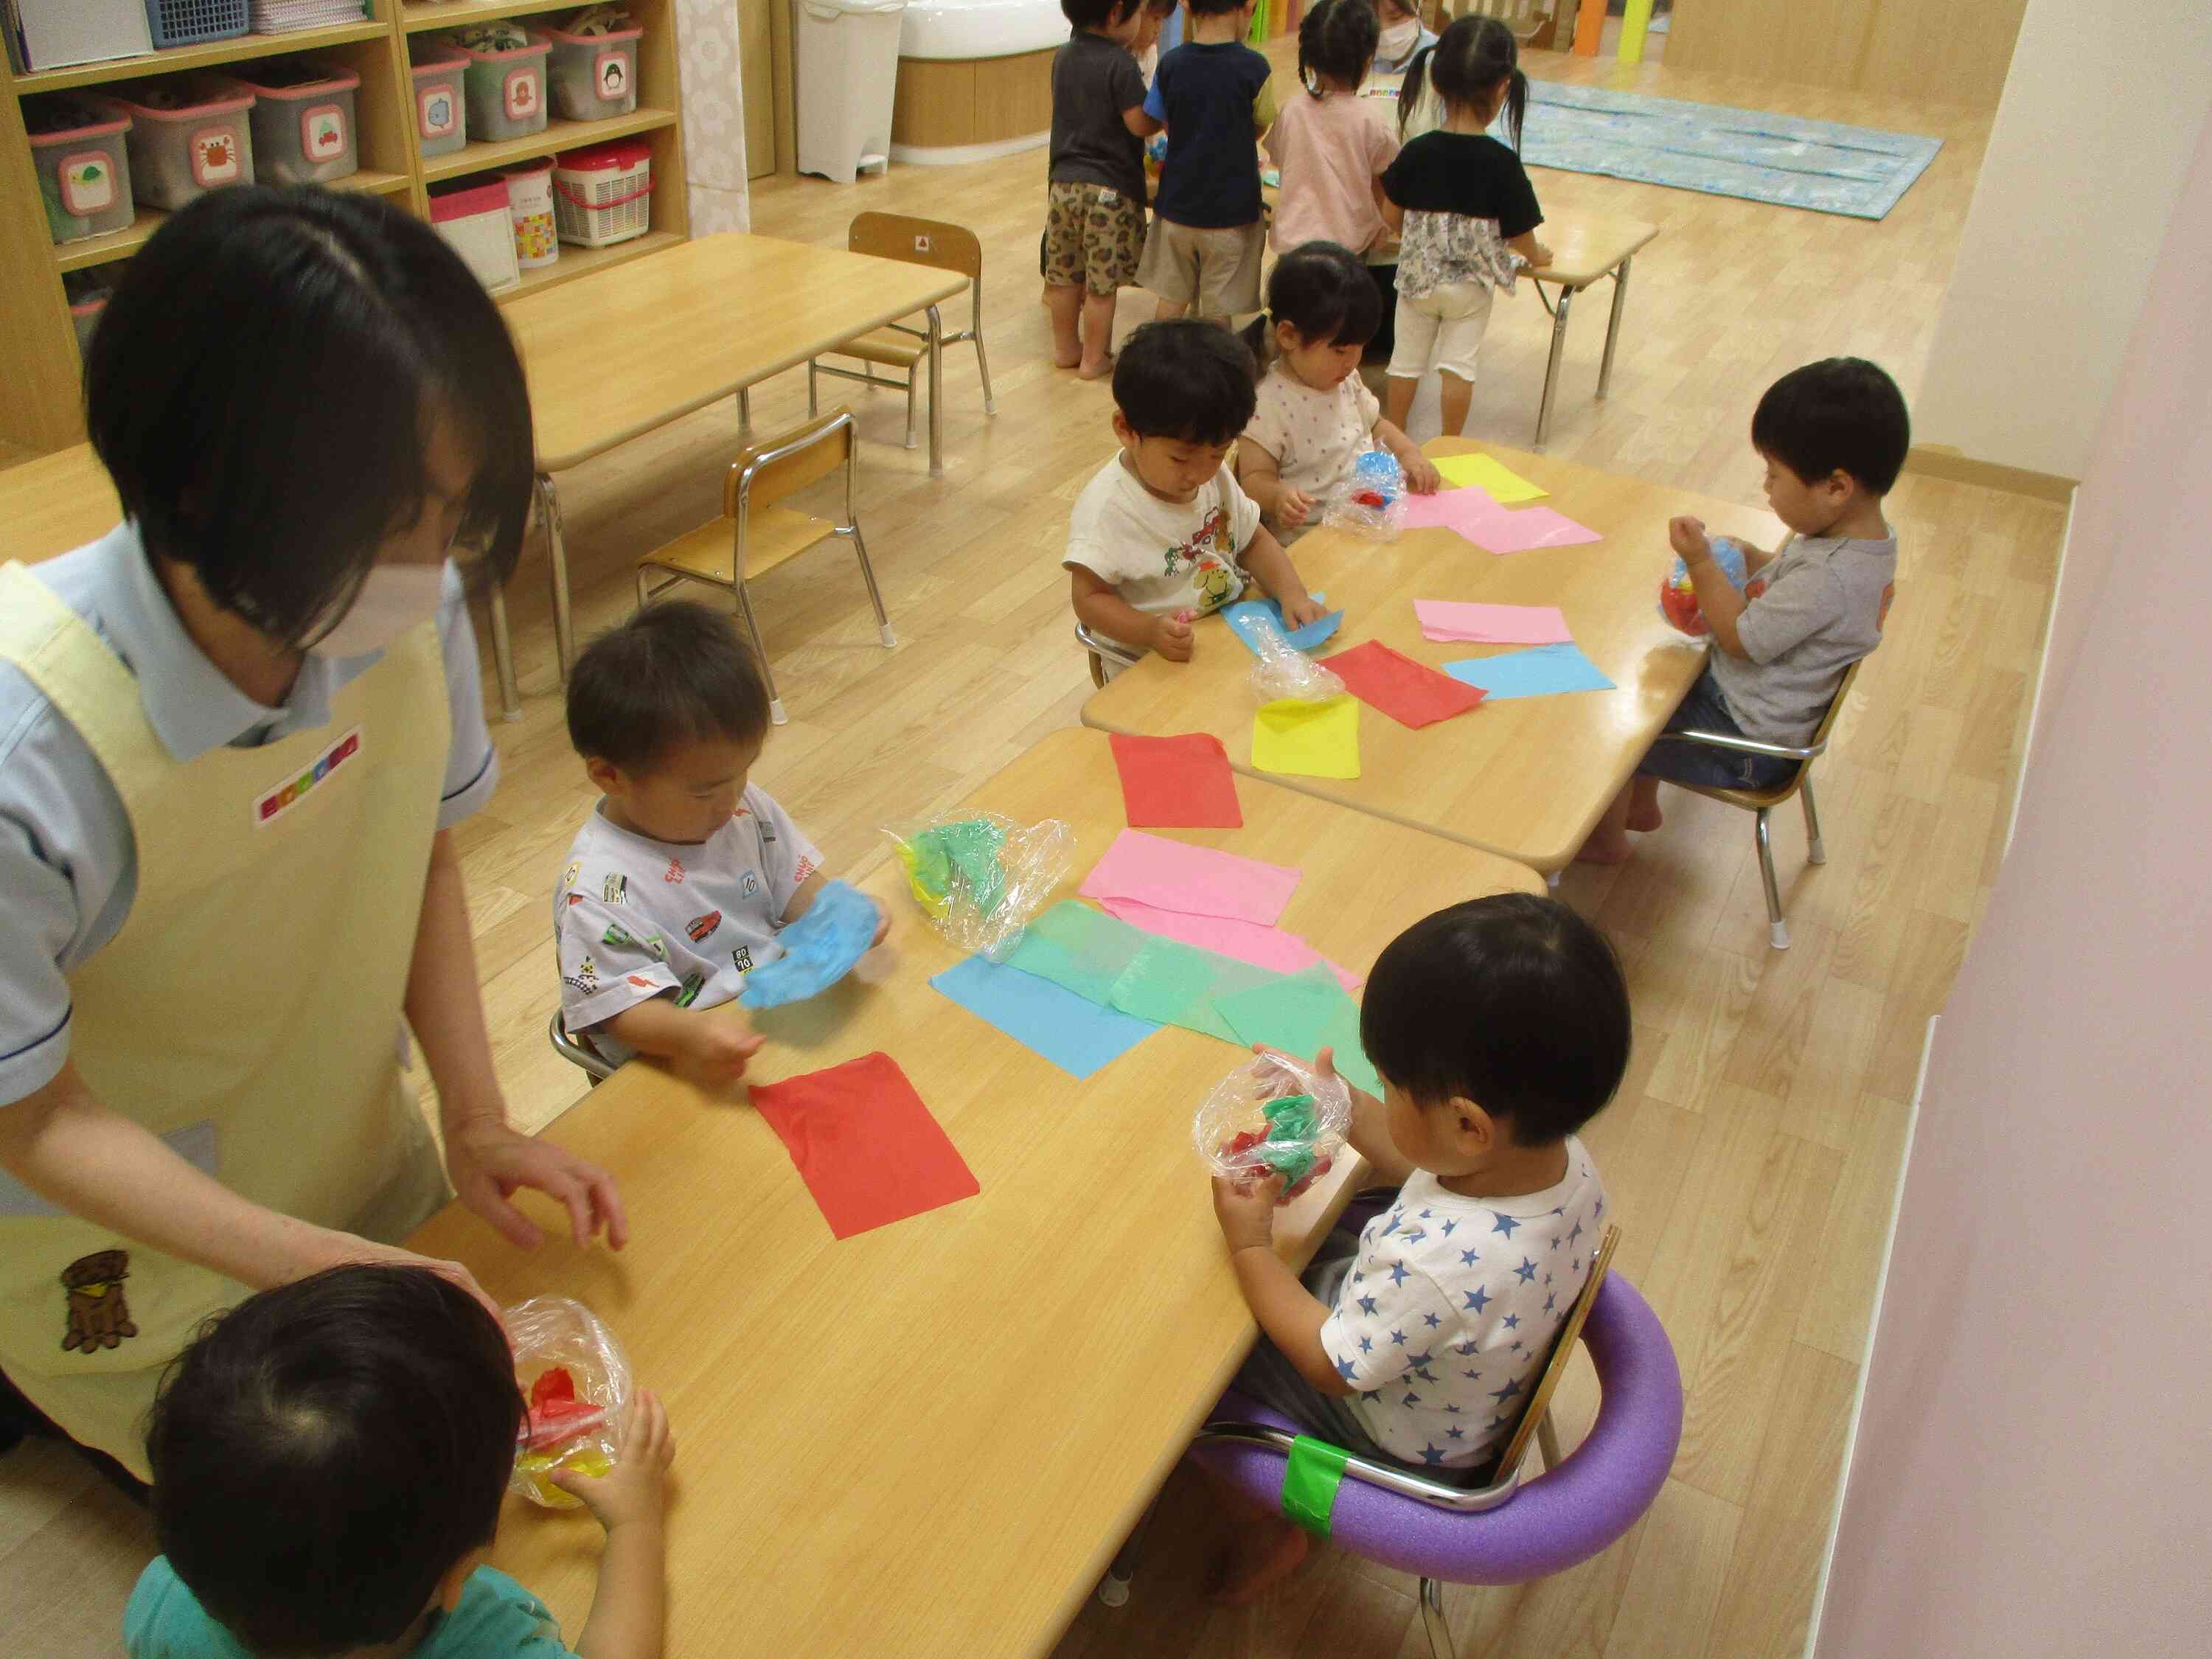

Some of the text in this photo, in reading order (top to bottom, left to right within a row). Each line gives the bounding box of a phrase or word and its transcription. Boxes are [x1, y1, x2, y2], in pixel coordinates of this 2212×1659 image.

[745, 877, 755, 892] 10
[736, 948, 746, 959] 80
[737, 959, 751, 970] 70
